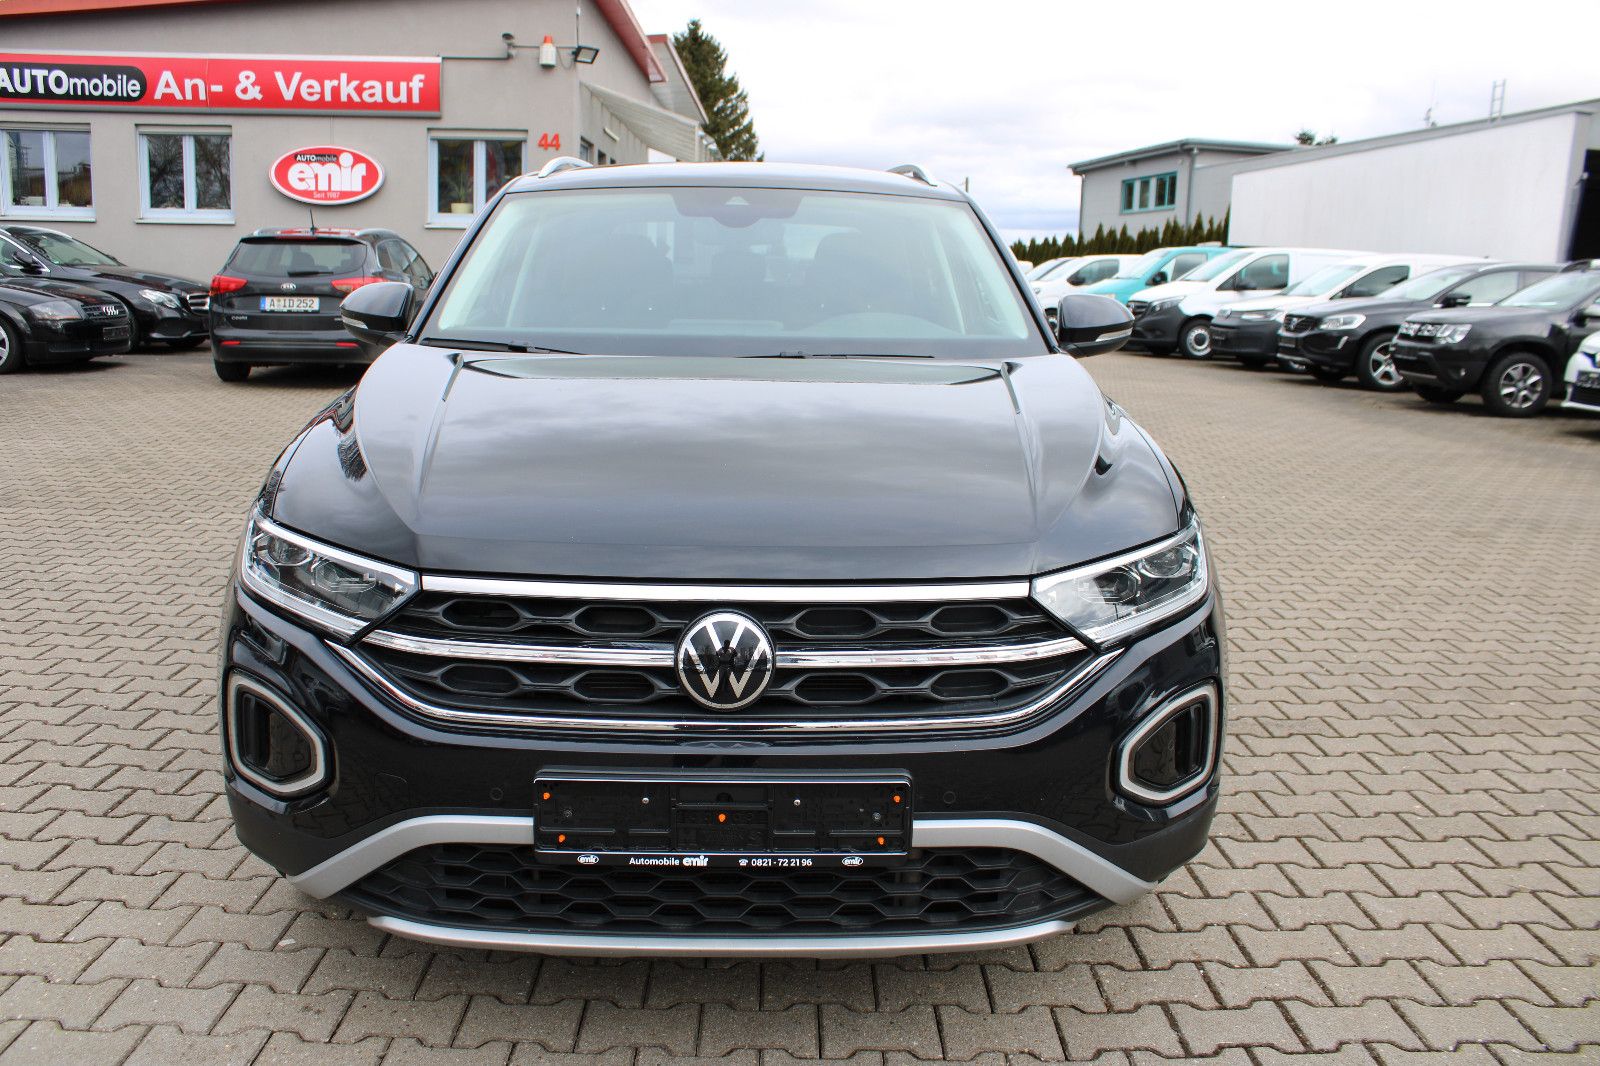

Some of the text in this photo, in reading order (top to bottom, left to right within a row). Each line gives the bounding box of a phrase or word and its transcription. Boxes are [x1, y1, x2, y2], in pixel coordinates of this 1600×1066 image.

[0, 67, 141, 98] AUTOmobile
[153, 70, 425, 104] An- & Verkauf
[538, 132, 560, 151] 44
[296, 154, 337, 162] AUTOmobile
[287, 152, 367, 192] emir
[270, 298, 315, 309] A ID 252
[629, 855, 709, 867] Automobile emir
[751, 858, 772, 867] 0821
[778, 858, 789, 867] 72
[790, 858, 800, 867] 21
[801, 858, 813, 867] 96
